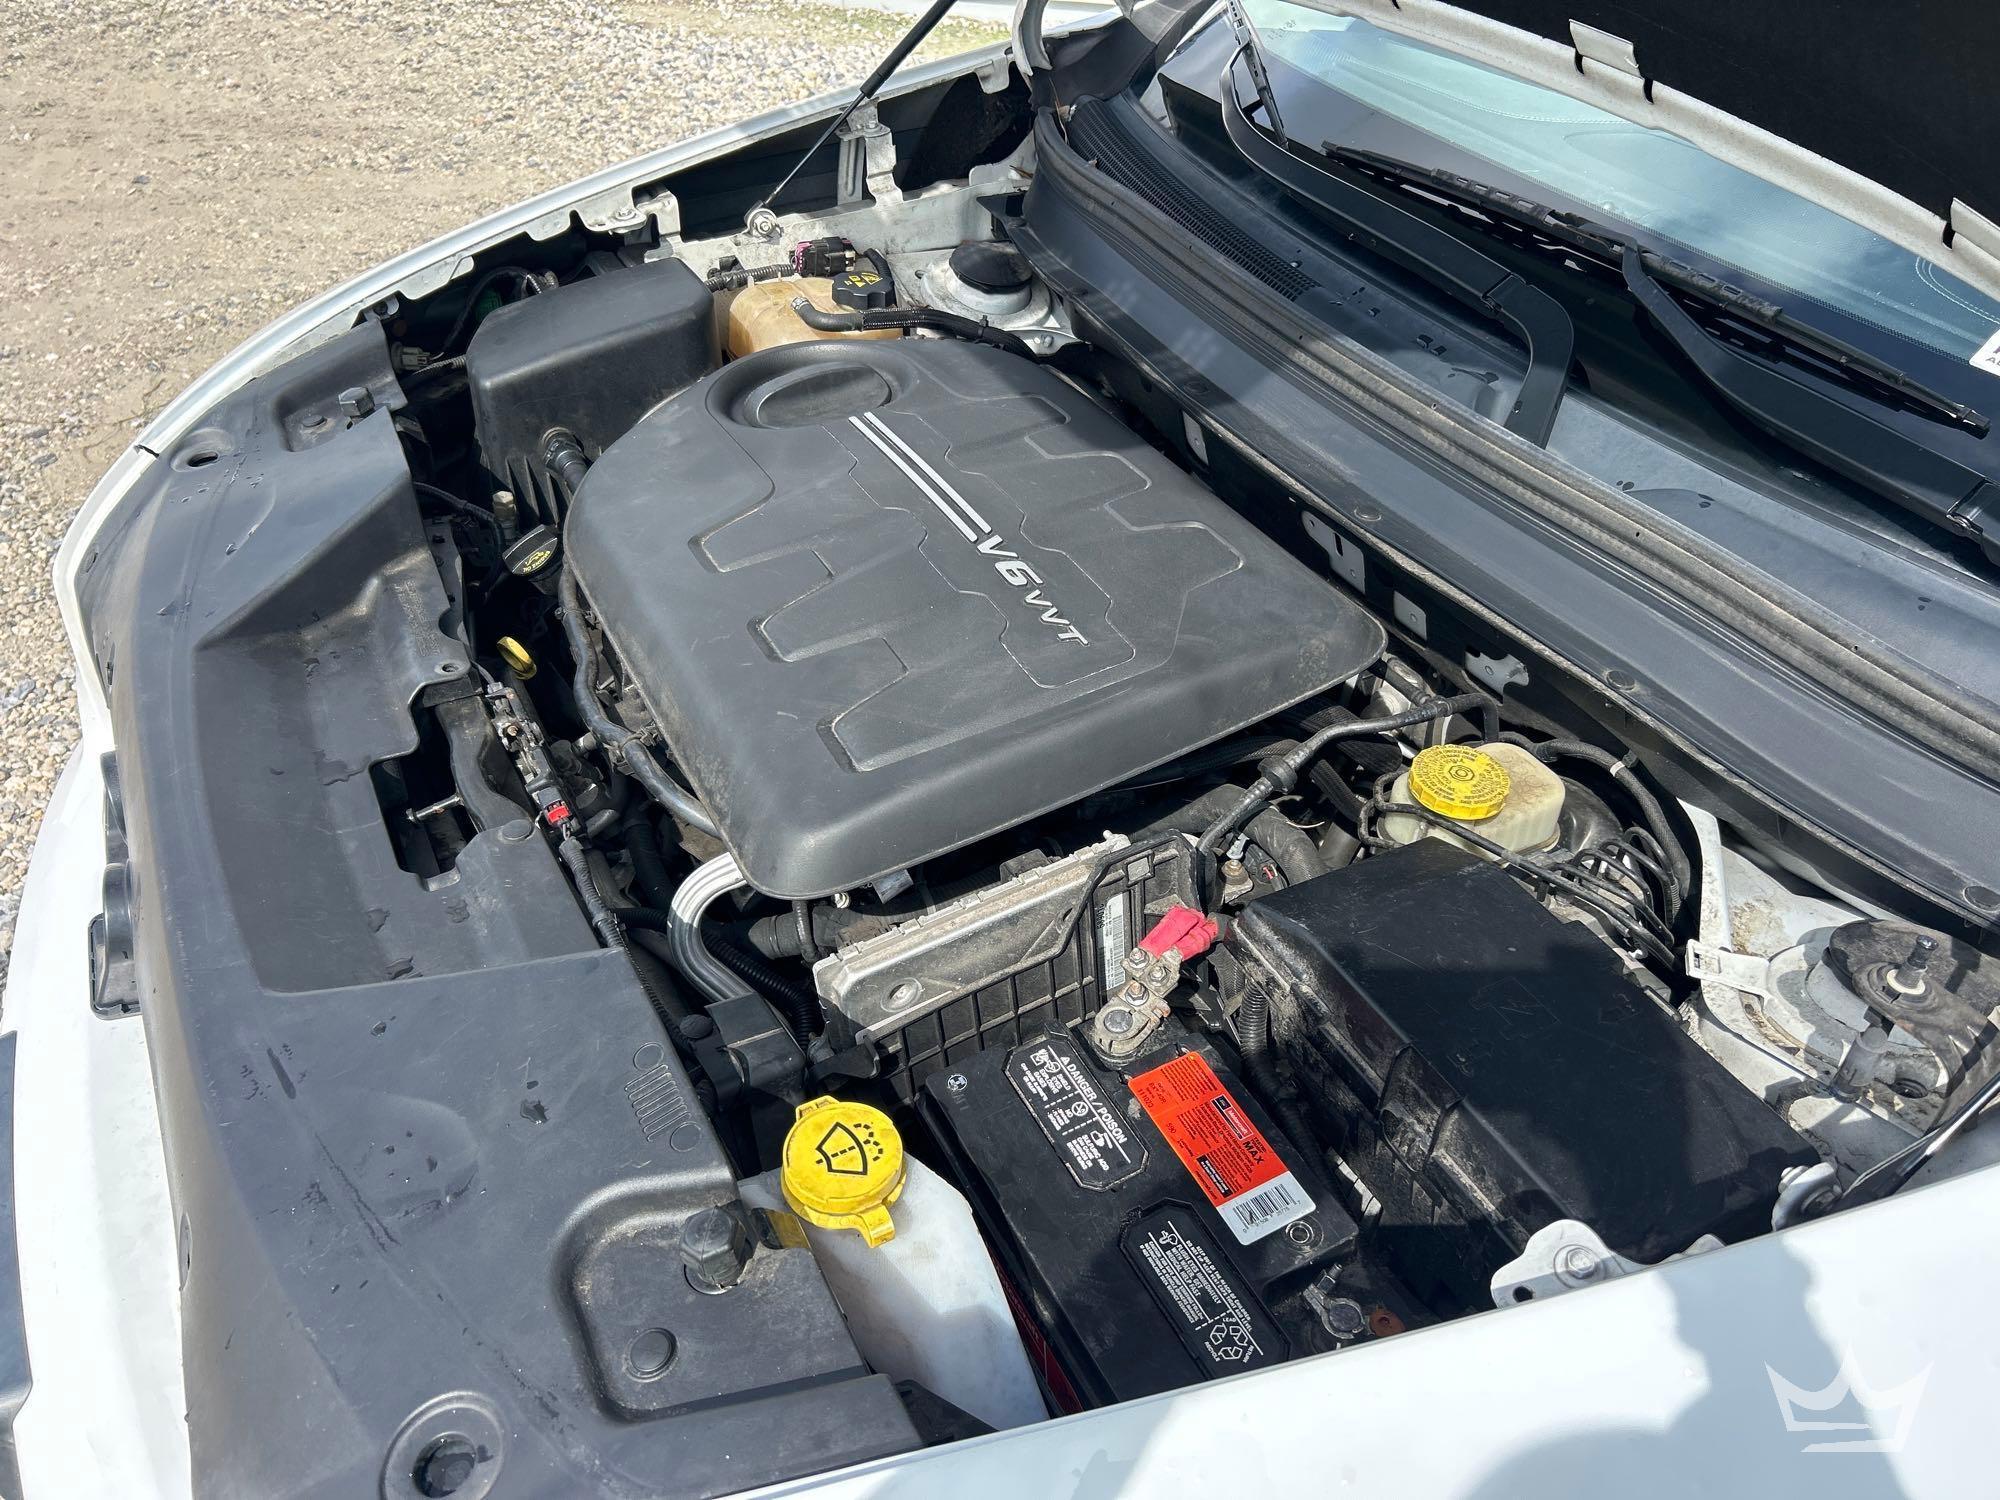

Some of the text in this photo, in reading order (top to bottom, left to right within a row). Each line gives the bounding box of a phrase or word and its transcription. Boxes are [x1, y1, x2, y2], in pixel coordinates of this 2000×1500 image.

[977, 535, 1089, 646] V6 VVT
[1050, 1076, 1063, 1089] EYES
[1064, 1108, 1073, 1117] NO
[1065, 1063, 1128, 1144] DANGER / POISON
[1081, 1133, 1109, 1171] SULFURIC ACID
[1242, 1140, 1264, 1164] MAX
[1164, 1249, 1200, 1296] MEDICAL HELP FAST
[1170, 1247, 1183, 1260] WITH
[1192, 1278, 1203, 1289] GET
[1175, 1244, 1221, 1304] FLUSH EYES IMMEDIATELY
[1203, 1340, 1220, 1361] RECYCLE
